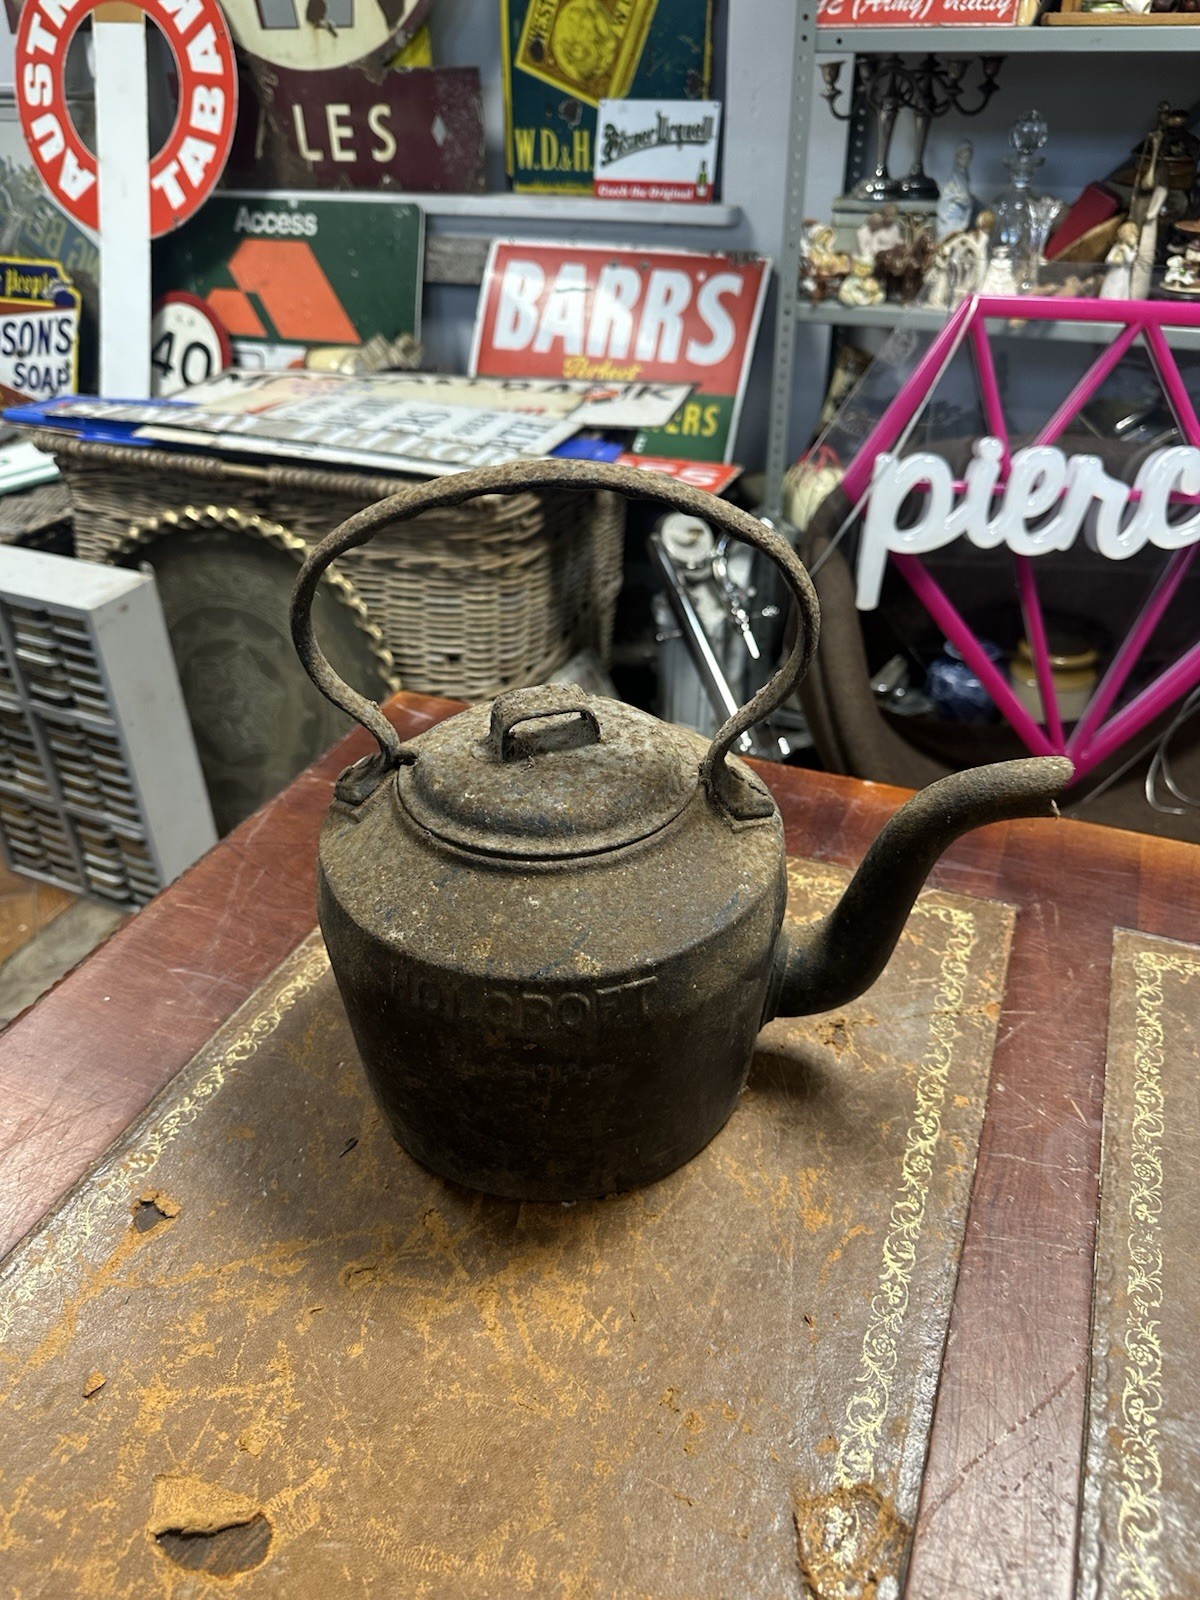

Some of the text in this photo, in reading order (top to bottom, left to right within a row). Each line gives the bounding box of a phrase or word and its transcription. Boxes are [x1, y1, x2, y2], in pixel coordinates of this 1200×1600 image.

[233, 205, 318, 236] Access
[492, 258, 745, 367] BARR'S
[13, 362, 71, 394] SOAP
[152, 331, 212, 387] 40
